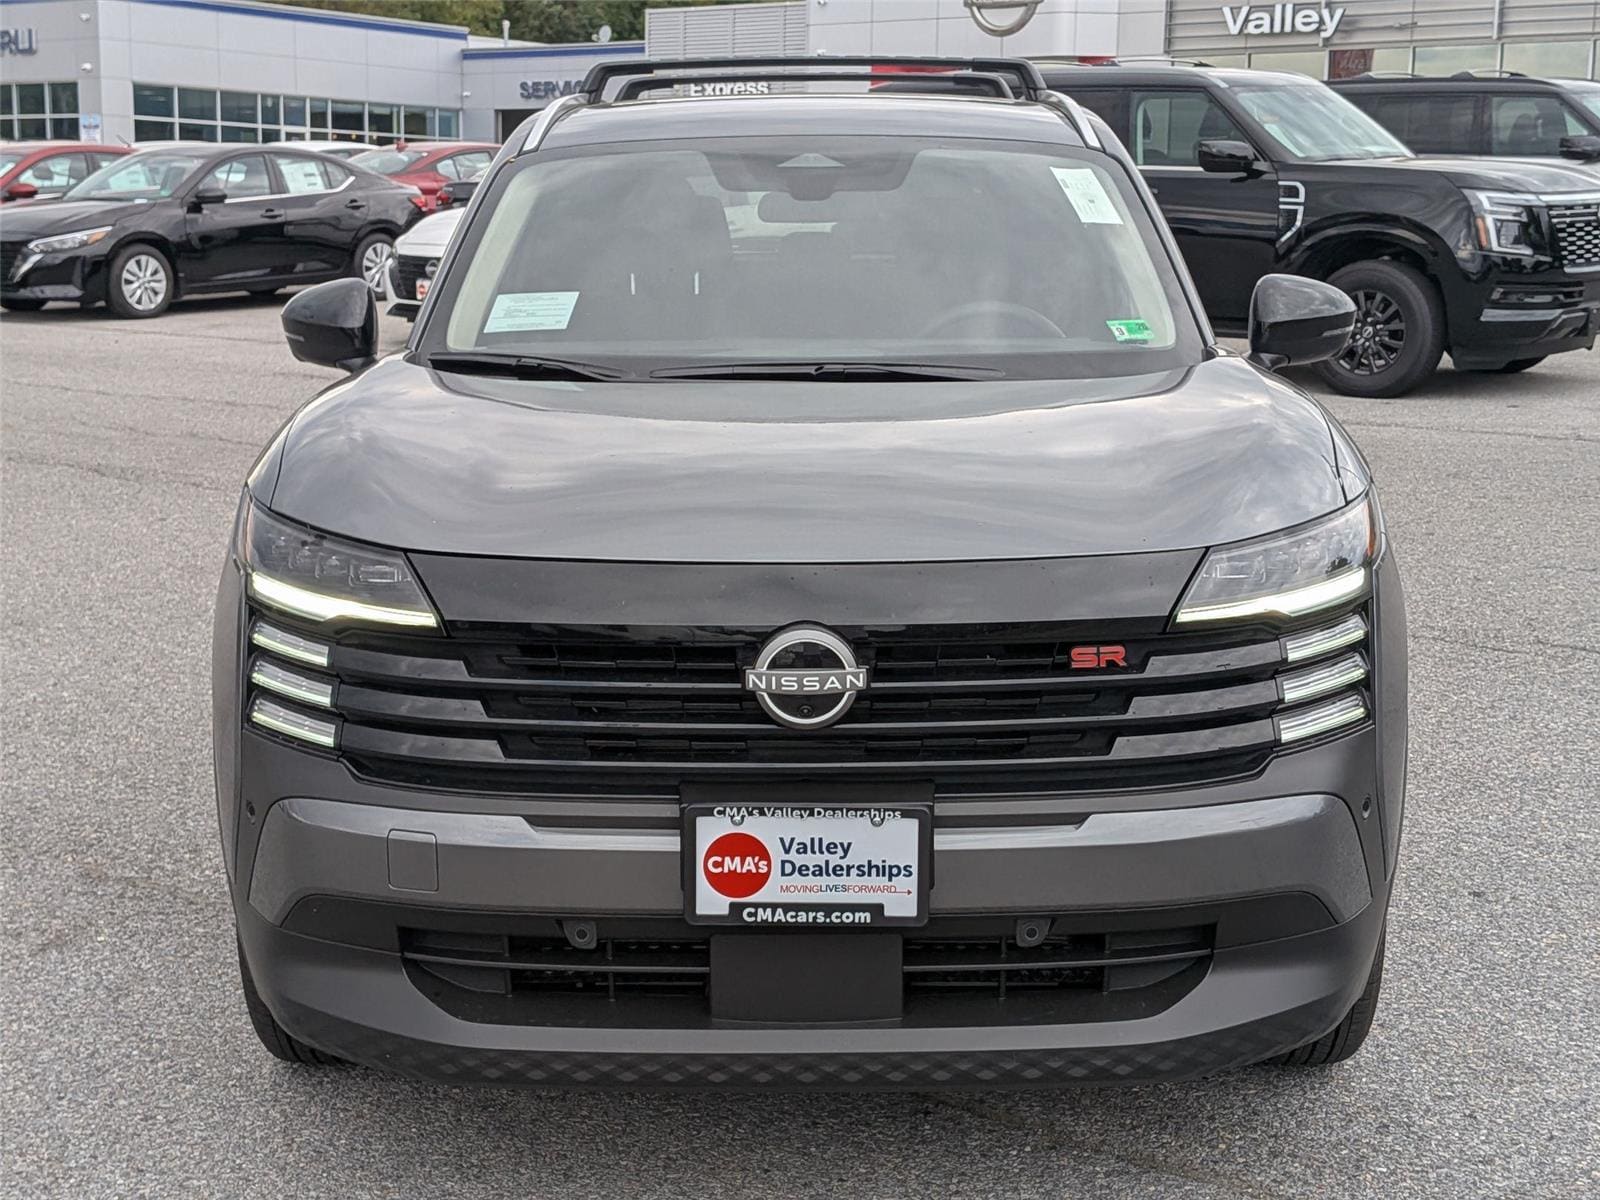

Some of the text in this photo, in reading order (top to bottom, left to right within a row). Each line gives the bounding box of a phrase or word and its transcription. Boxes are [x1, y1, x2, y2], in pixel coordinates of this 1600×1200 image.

[1222, 3, 1346, 39] Valley
[1070, 645, 1128, 668] SR
[748, 672, 865, 691] NISSAN
[713, 806, 902, 821] CMA's Valley Dealerships
[779, 836, 853, 860] Valley
[707, 855, 769, 874] CMA's
[780, 859, 914, 882] Dealerships
[742, 907, 872, 924] CMAcars.com
